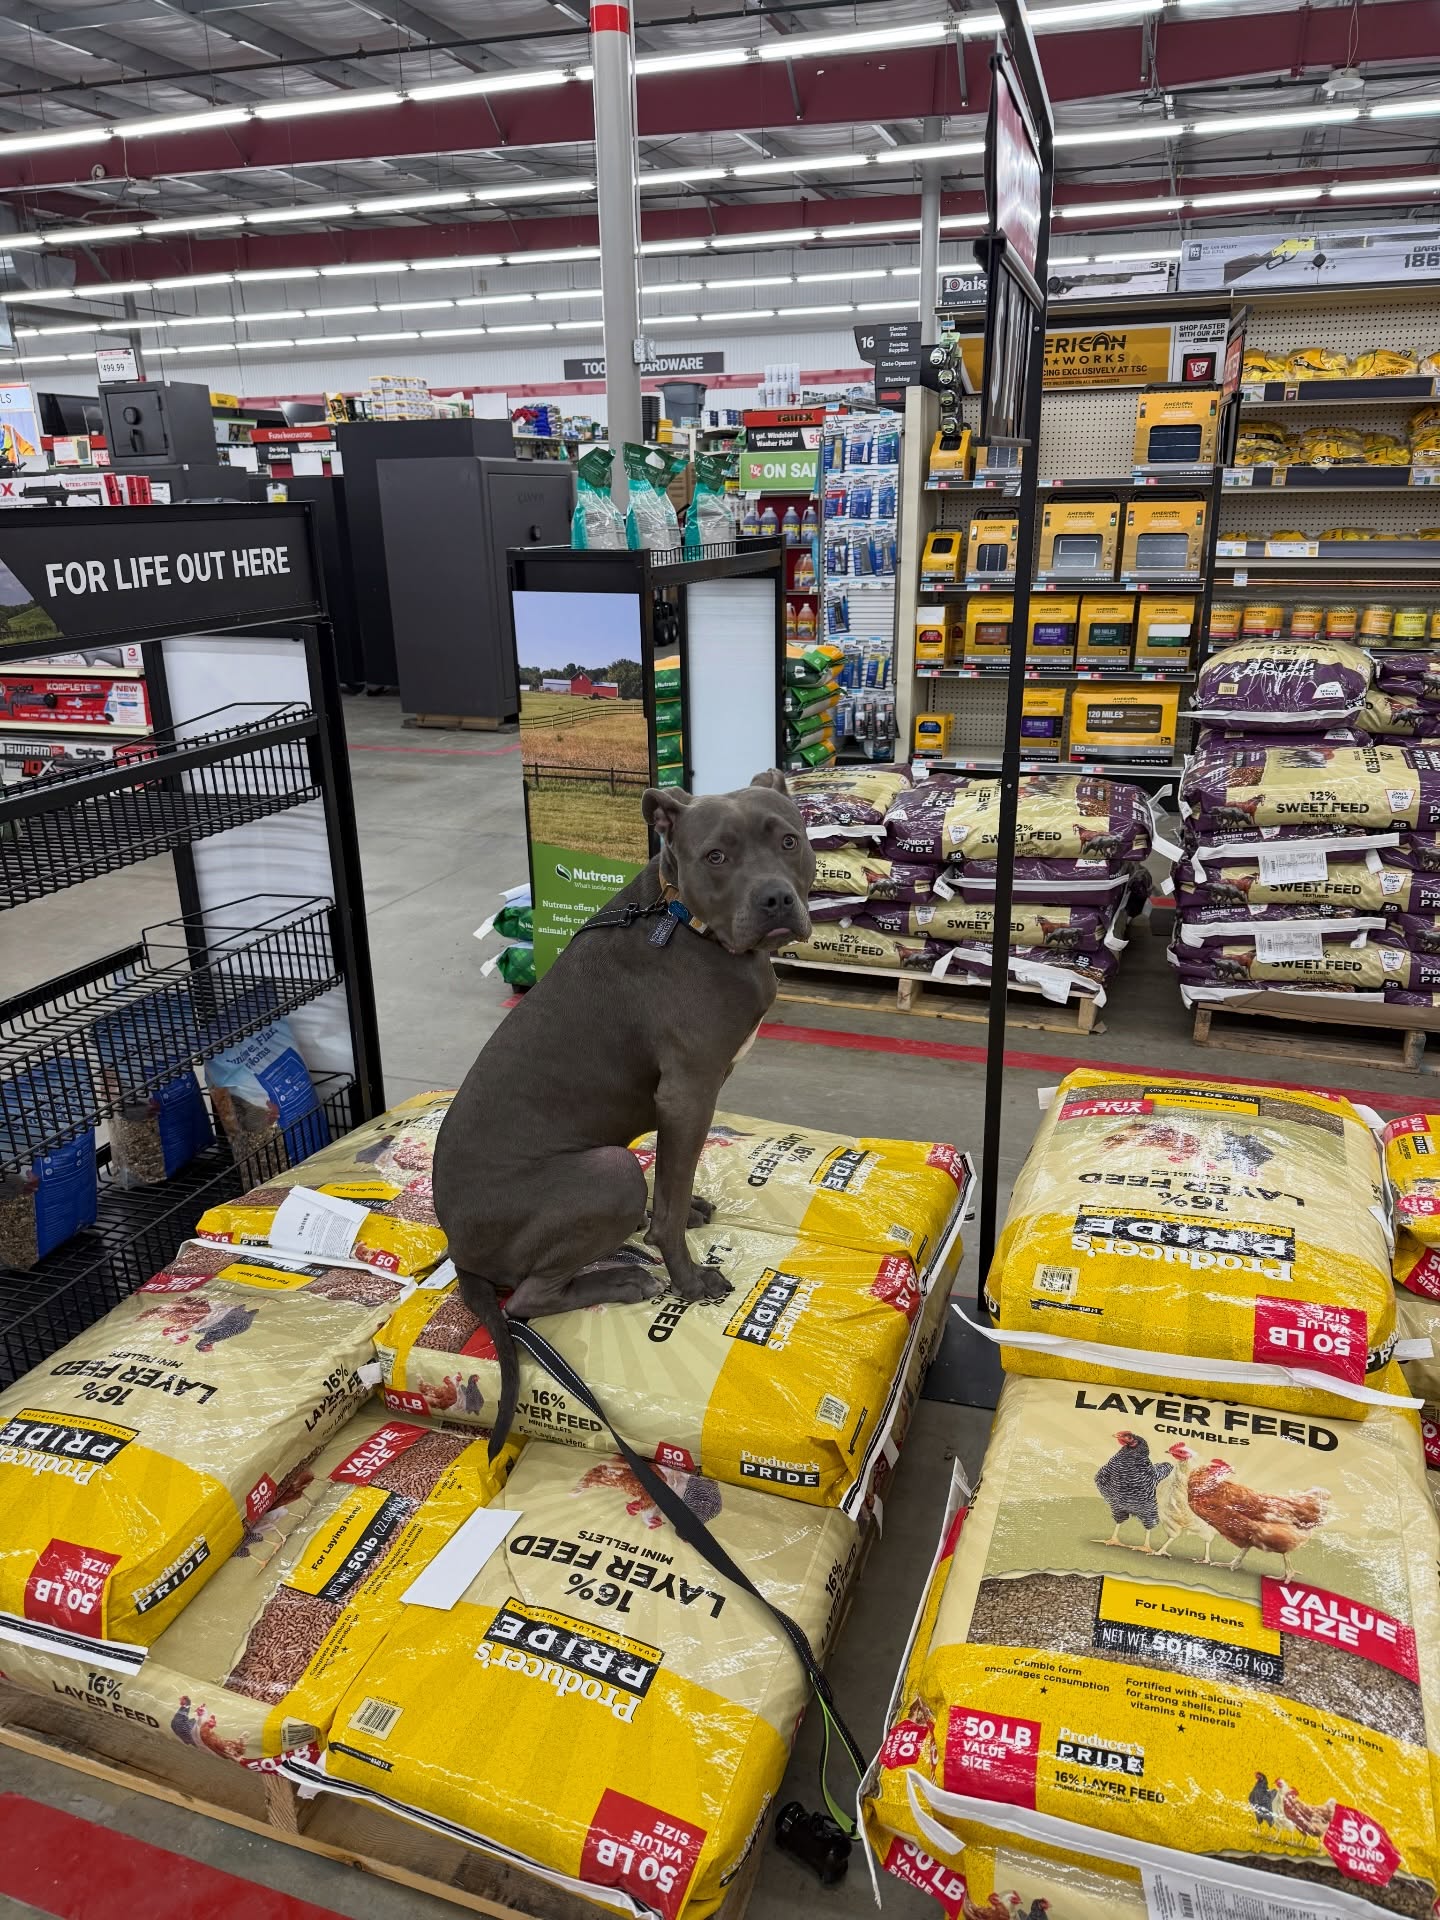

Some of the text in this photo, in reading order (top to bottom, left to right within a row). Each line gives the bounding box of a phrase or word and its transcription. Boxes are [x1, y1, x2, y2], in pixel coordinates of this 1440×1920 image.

[1179, 322, 1225, 332] SHOP FASTER
[1179, 330, 1196, 338] WITH
[1210, 329, 1226, 337] APP
[861, 336, 875, 349] 16
[888, 341, 909, 349] Fencing
[1045, 331, 1127, 354] ERICAN
[640, 357, 704, 372] ARDWARE
[894, 359, 917, 367] Openers
[1062, 365, 1148, 376] EXCLUSIVELY AT TSC
[1063, 353, 1125, 366] WORKS
[1190, 360, 1208, 378] TSC
[755, 432, 767, 441] gal.
[767, 431, 799, 440] Windshield
[756, 439, 793, 448] Washer Fluid
[763, 463, 786, 479] ON
[45, 546, 291, 597] FOR LIFE OUT HERE
[115, 685, 138, 693] NEW
[1088, 710, 1124, 719] 120 MILES
[5, 744, 51, 756] SWARM
[1310, 791, 1337, 801] 12%
[1276, 803, 1370, 814] SWEET FEED
[1029, 830, 1062, 841] FEED
[573, 867, 624, 884] Nutrena
[822, 869, 852, 880] FEED
[1270, 883, 1362, 895] SWEET FEED
[542, 899, 595, 912] Nutrena offers
[552, 914, 572, 923] feeds
[947, 919, 990, 930] SWEET
[537, 927, 569, 936] animals'
[838, 933, 860, 944] 12%
[813, 941, 884, 957] SWEET FEED
[1271, 960, 1362, 972] SWEET FEED
[1183, 1180, 1305, 1207] LAYER
[1082, 1217, 1287, 1256] PRIDE
[375, 1255, 394, 1267] 50
[1070, 1235, 1294, 1282] Producer's
[743, 1275, 798, 1340] PRIDE
[1268, 1328, 1305, 1350] LB
[1313, 1335, 1351, 1356] 50
[50, 1359, 219, 1405] LAYER FEED
[74, 1381, 134, 1406] 16%
[531, 1389, 566, 1410] 16%
[555, 1411, 603, 1432] FEED
[1074, 1390, 1211, 1430] LAYER
[1224, 1409, 1338, 1453] FEED
[0, 1423, 121, 1459] PRIDE
[1153, 1423, 1251, 1447] CRUMBLES
[340, 1428, 400, 1476] VALUE
[356, 1448, 396, 1478] SIZE
[662, 1447, 685, 1462] 50
[740, 1450, 820, 1473] Producer's
[742, 1463, 819, 1485] PRIDE
[250, 1480, 268, 1505] 50
[577, 1530, 674, 1566] MINI PELLETS
[137, 1543, 211, 1614] PRIDE
[509, 1534, 727, 1619] LAYER FEED
[34, 1579, 98, 1615] 50 LB
[564, 1572, 634, 1613] 16%
[1134, 1599, 1245, 1628] For Laying Hens
[1278, 1586, 1398, 1644] VALUE
[1278, 1605, 1360, 1647] SIZE
[493, 1614, 651, 1690] PRIDE
[1102, 1627, 1124, 1644] NET
[1152, 1635, 1184, 1655] 50
[1184, 1639, 1208, 1660] lb
[1252, 1656, 1276, 1678] kg)
[1013, 1658, 1082, 1676] Crumble form
[87, 1672, 124, 1700] 16%
[473, 1641, 643, 1724] Producer's
[984, 1666, 1110, 1692] encourages consumption
[1125, 1677, 1244, 1708] Fortified with calcium
[1126, 1687, 1242, 1720] for strong shells, plus
[52, 1680, 160, 1729] LAYER FEED
[1130, 1700, 1236, 1729] vitamins & minerals
[964, 1716, 1032, 1747] 50 LB
[1058, 1727, 1145, 1756] Producer's
[1296, 1713, 1385, 1753] egg-laying hens
[898, 1730, 918, 1757] 50
[962, 1739, 1006, 1760] VALUE
[961, 1755, 991, 1772] SIZE
[1059, 1743, 1144, 1772] PRIDE
[1054, 1770, 1080, 1785] 16%
[1082, 1775, 1127, 1796] LAYER
[1129, 1786, 1166, 1804] FEED
[653, 1820, 692, 1847] SIZE
[1341, 1820, 1381, 1847] 50
[632, 1829, 683, 1862] VALUE
[1338, 1843, 1385, 1864] POUND
[596, 1837, 679, 1895] 50 LB
[894, 1852, 934, 1897] VALUE
[1348, 1857, 1377, 1875] BAG
[931, 1862, 966, 1901] LB
